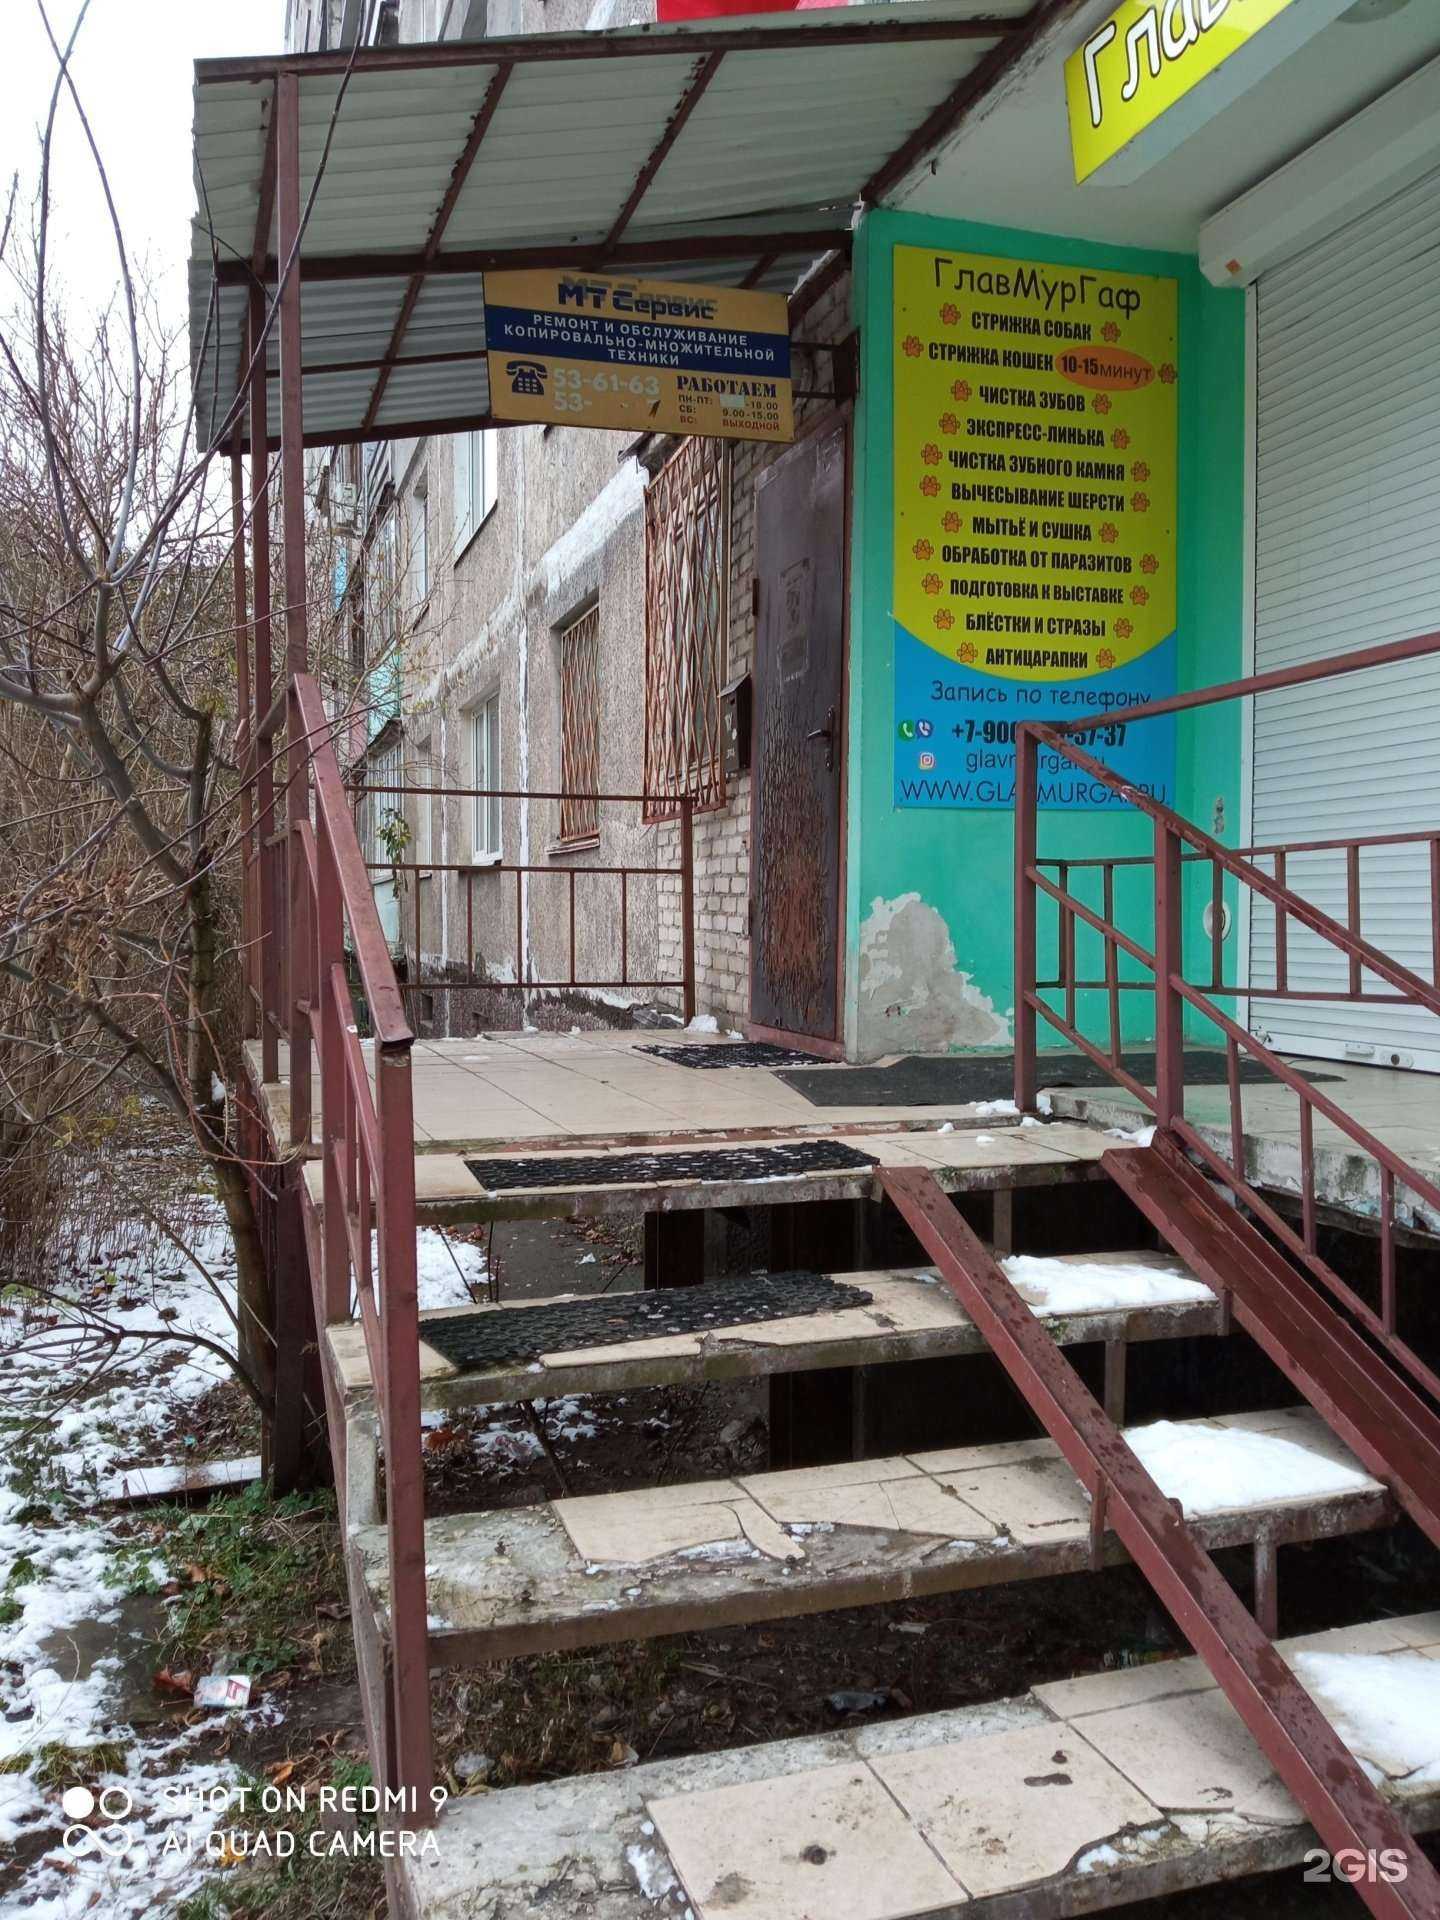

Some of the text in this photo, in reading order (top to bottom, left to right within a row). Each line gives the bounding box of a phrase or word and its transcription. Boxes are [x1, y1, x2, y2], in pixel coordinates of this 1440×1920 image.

[934, 257, 1141, 320] ГлавМурГаф
[533, 314, 748, 346] РЕМОНТ И ОБСЛУЖИВАНИЕ
[971, 311, 1092, 342] СТРИЖКА СОБАК
[504, 323, 775, 361] КОПИРОВАЛЬНО-МНОЖИТЕЛЬНОЙ
[608, 348, 679, 366] ТЕХНИКИ
[928, 342, 1000, 367] СТРИЖКА
[1000, 350, 1053, 372] КОШЕК
[553, 367, 660, 396] 53-61-63
[677, 376, 777, 398] РАБОТАЕМ
[678, 394, 713, 405] ПН-ПТ:
[679, 404, 696, 414] СБ:
[979, 385, 1086, 412] ЧИСТКА ЗУБОВ
[722, 419, 780, 431] ВЫХОДНОЙ
[966, 418, 1105, 447] ЭКСПРЕСС-ЛИНЬКА
[948, 451, 1125, 481] ЧИСТКА ЗУБНОГО КАМНЯ
[951, 483, 1125, 512] ВЫЧЕСЫВАНИЕ ШЕРСТИ
[972, 516, 1092, 541] МЫТЬЁ И СУШКА
[942, 545, 1132, 574] ОБРАБОТКА ОТ ПАРАЗИТОВ
[950, 579, 1124, 604] ПОДГОТОВКА К ВЫСТАВКЕ
[966, 611, 1106, 637] БЛЁСТКИ И СТРАЗЫ
[985, 648, 1088, 668] АНТИЦАРАПКИ
[931, 680, 1008, 702] Запись
[1016, 688, 1042, 704] по
